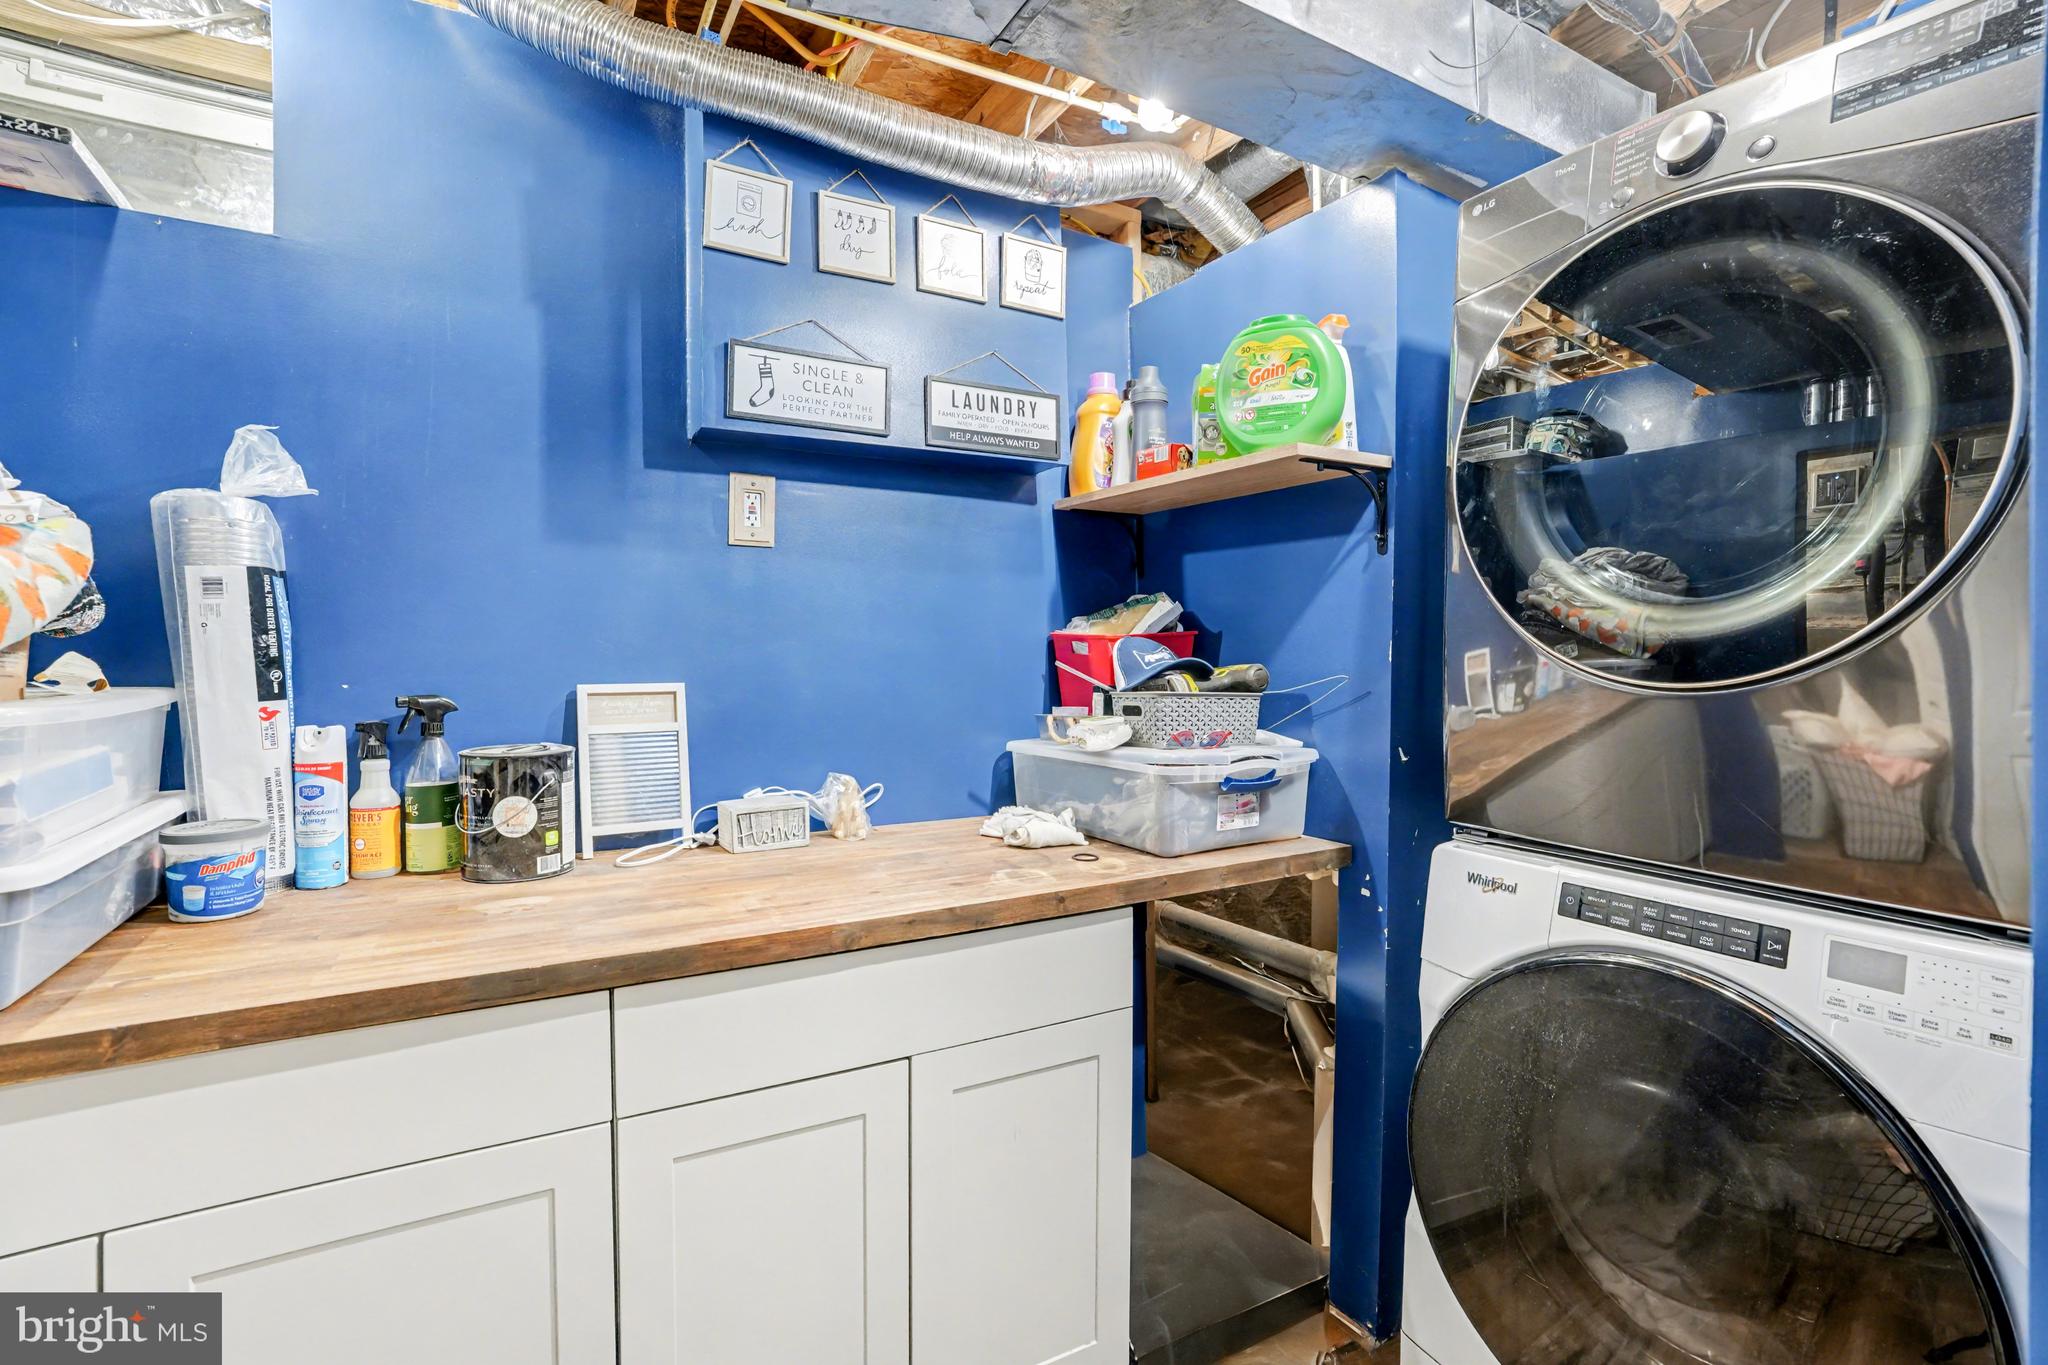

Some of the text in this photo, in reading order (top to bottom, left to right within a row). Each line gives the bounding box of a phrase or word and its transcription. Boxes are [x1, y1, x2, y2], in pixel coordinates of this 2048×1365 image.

[713, 217, 783, 240] wash
[840, 234, 876, 260] dry
[1013, 280, 1056, 300] repeat
[792, 362, 864, 384] SINGLE &
[1248, 362, 1287, 387] Gain
[802, 380, 854, 398] CLEAN
[782, 394, 872, 414] LOOKING FOR THE
[782, 402, 873, 422] PERFECT PARTNER
[952, 389, 1037, 419] LAUNDRY
[938, 410, 960, 419] FAMILY
[962, 412, 994, 424] OPERATED
[1002, 418, 1020, 426] OPEN
[1028, 422, 1050, 431] HOURS
[949, 431, 1040, 450] HELP ALWAYS WANTED
[264, 575, 279, 656] IDEAL FOR DRYER VENTING
[280, 618, 291, 648] DUTY
[277, 803, 285, 813] GAS
[198, 850, 256, 876] DampRid
[1467, 870, 1518, 894] Whirlpool
[1730, 927, 1751, 936] TOWELS
[1730, 944, 1747, 953] QUICK
